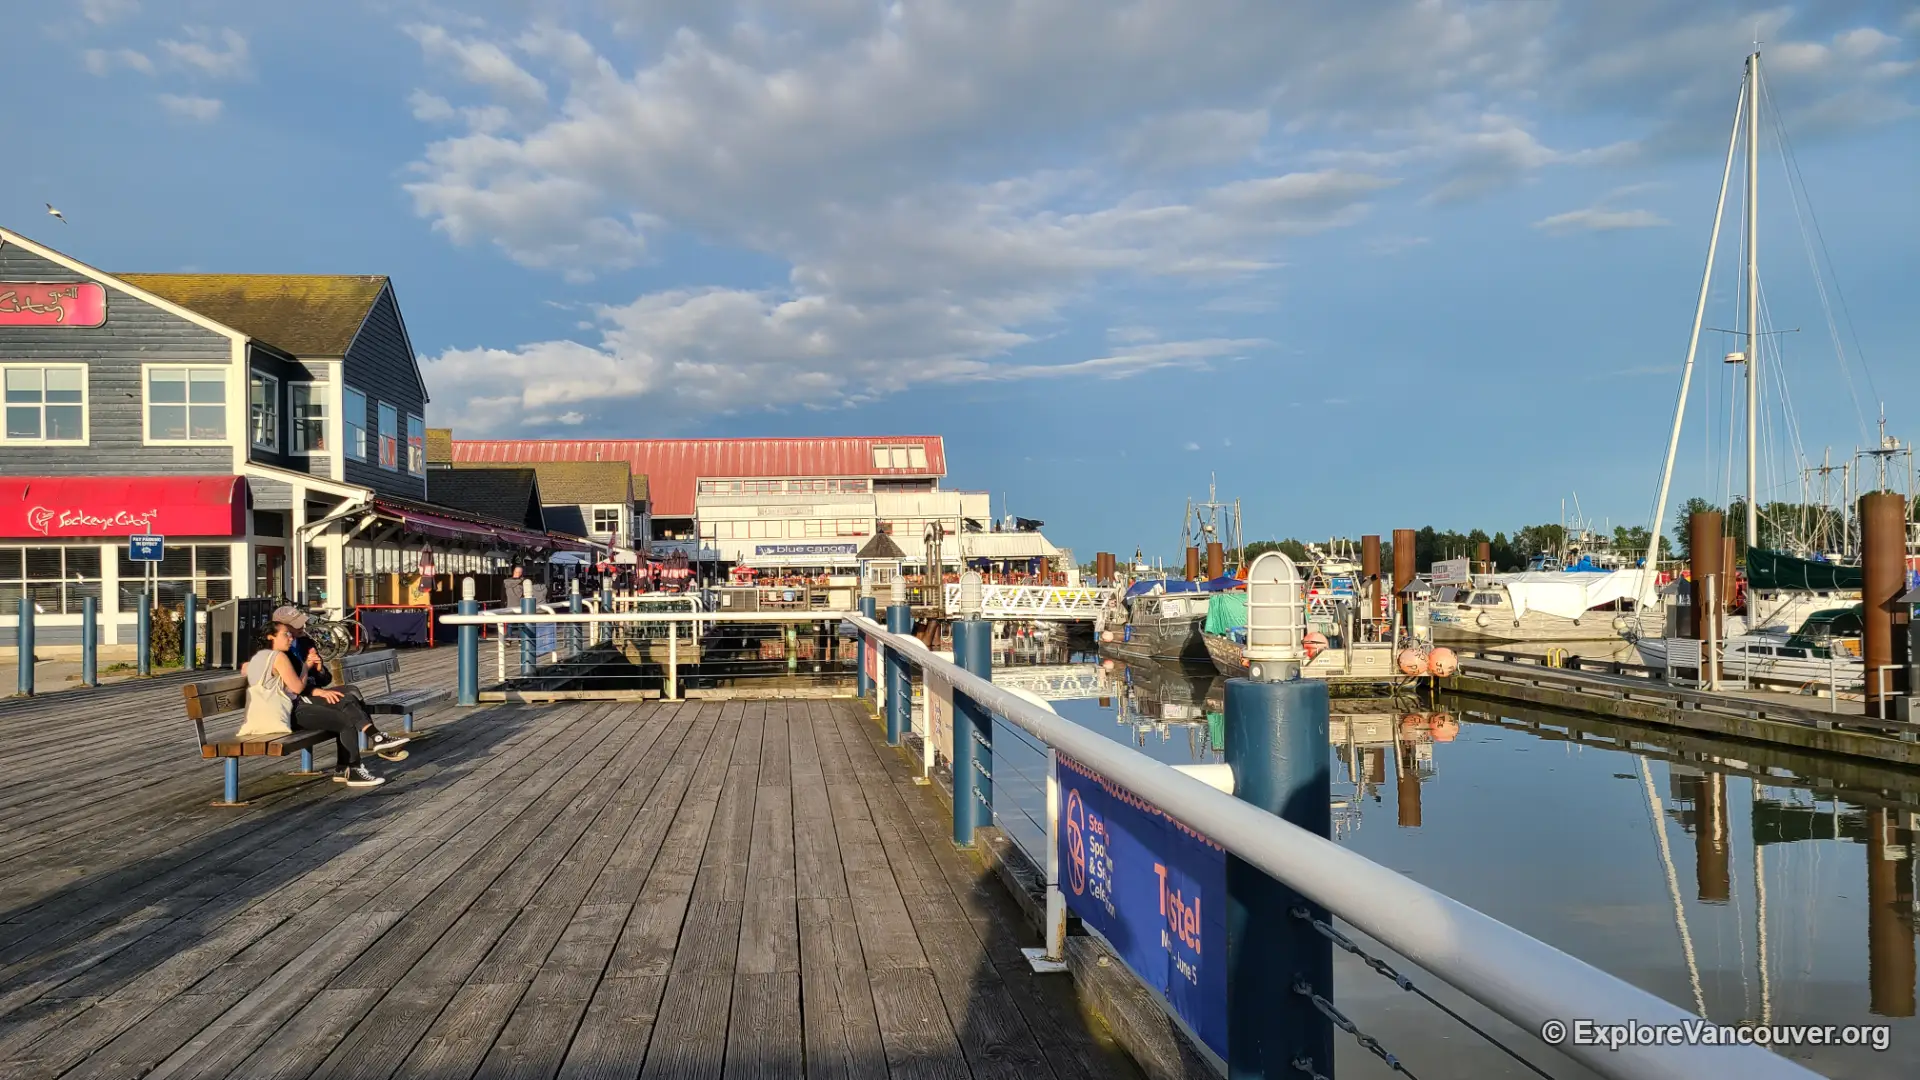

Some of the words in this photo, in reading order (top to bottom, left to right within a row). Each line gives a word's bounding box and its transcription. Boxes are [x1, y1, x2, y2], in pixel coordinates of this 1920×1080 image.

[59, 509, 114, 531] Sockeye
[777, 545, 804, 553] blue
[806, 545, 846, 554] canoe
[1177, 951, 1191, 981] June
[1192, 964, 1198, 986] 5
